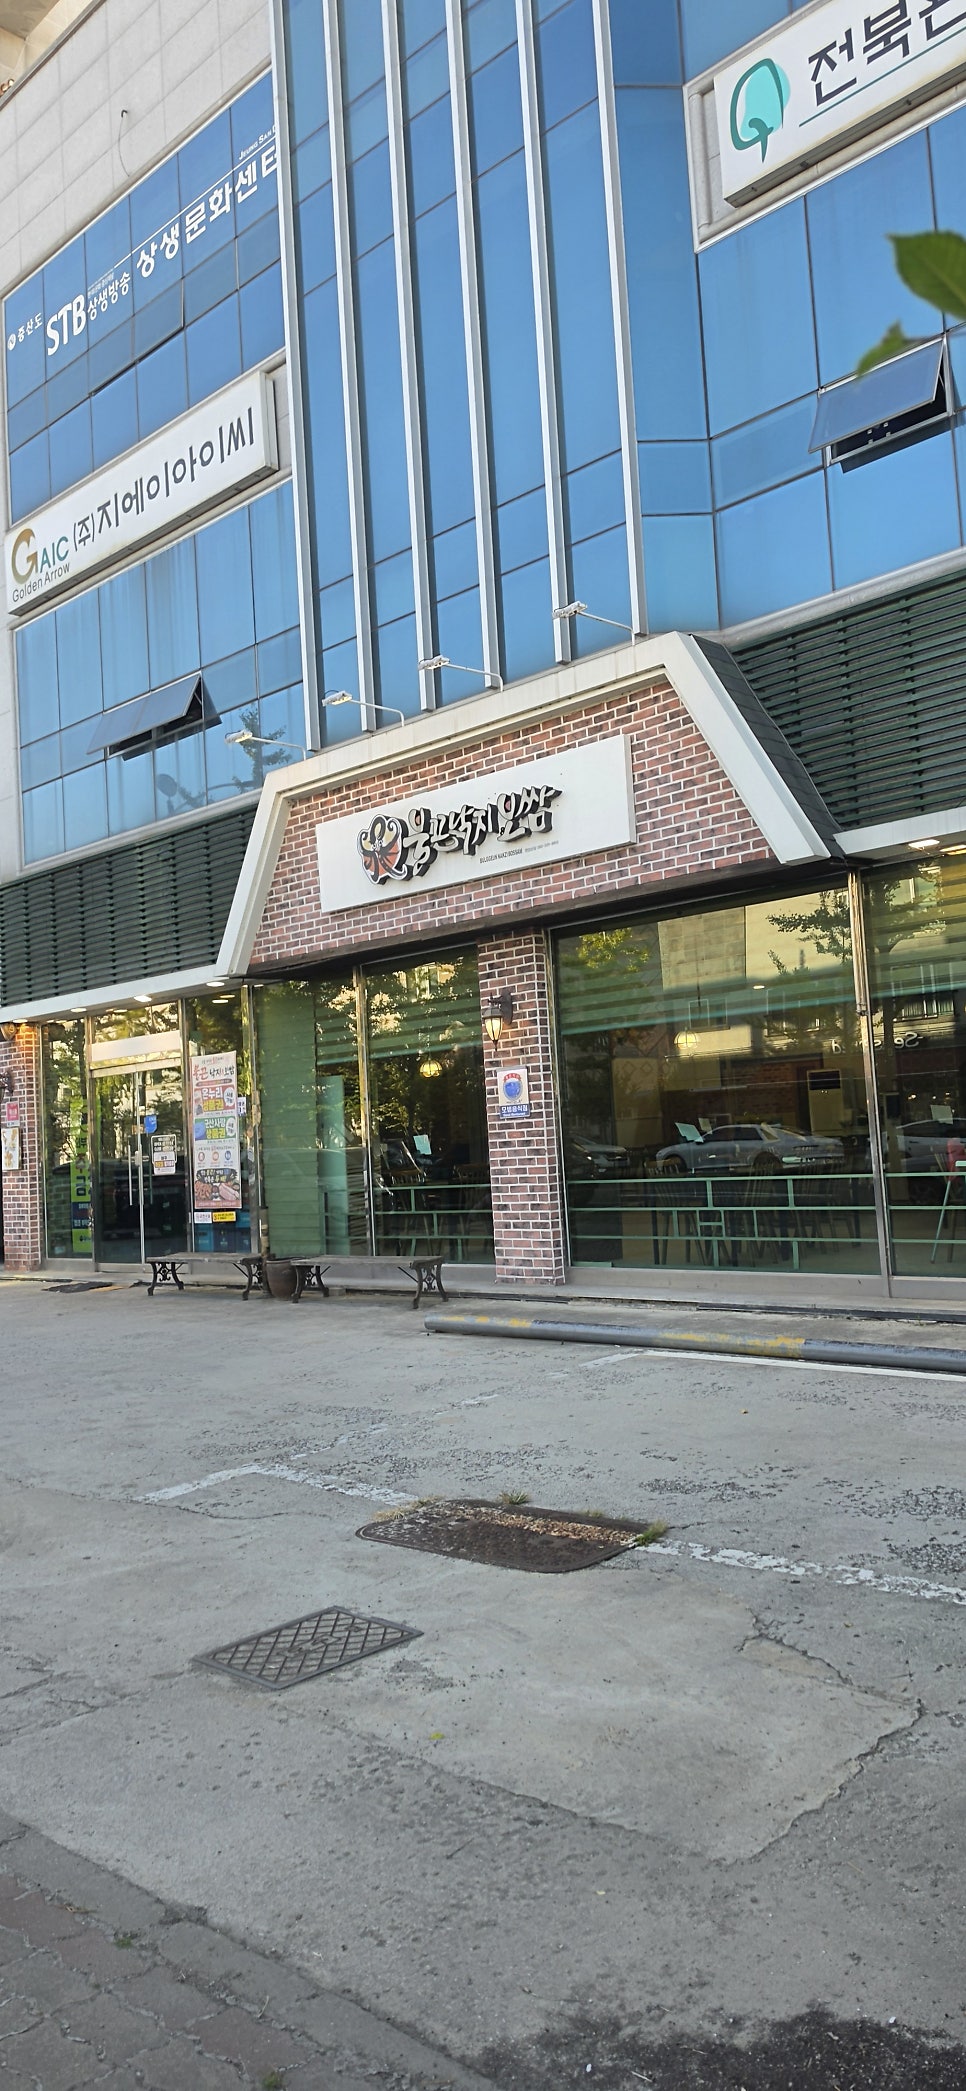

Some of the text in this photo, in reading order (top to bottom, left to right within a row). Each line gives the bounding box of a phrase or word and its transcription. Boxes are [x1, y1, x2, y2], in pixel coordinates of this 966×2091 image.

[87, 271, 131, 320] 상생방송
[47, 294, 86, 355] STB
[12, 562, 71, 603] Golden Arrow
[201, 1087, 223, 1099] 온누리
